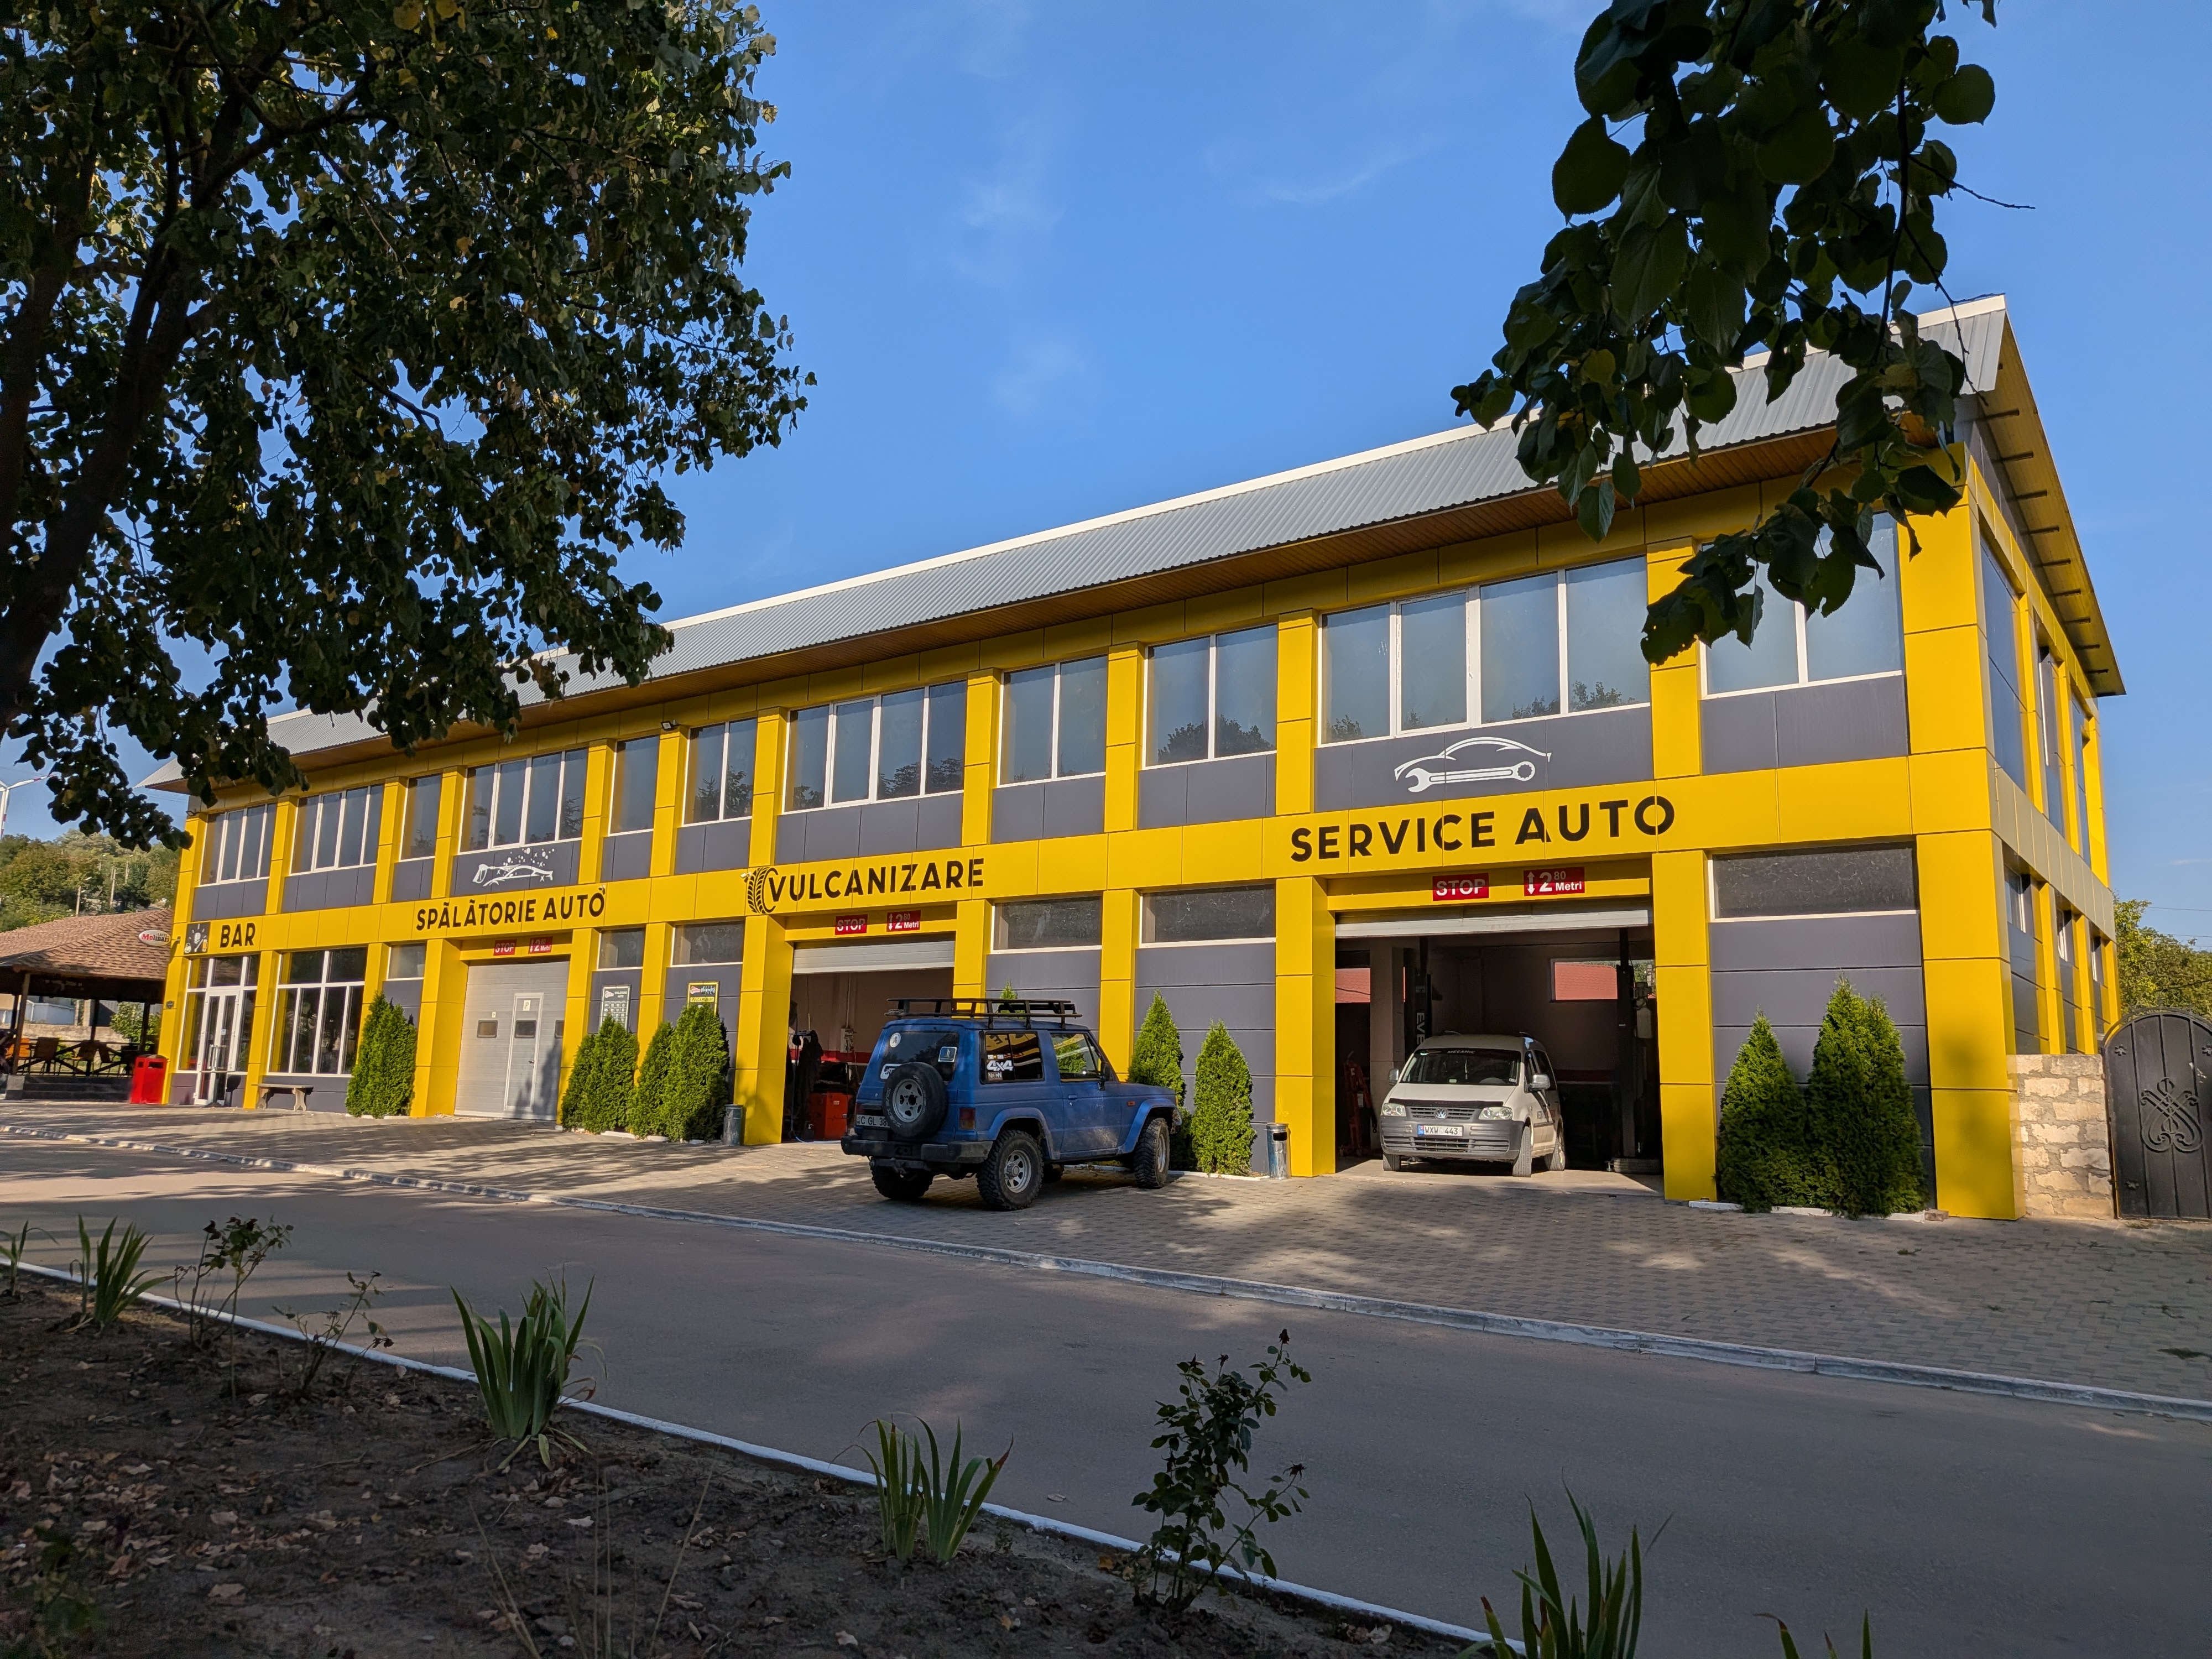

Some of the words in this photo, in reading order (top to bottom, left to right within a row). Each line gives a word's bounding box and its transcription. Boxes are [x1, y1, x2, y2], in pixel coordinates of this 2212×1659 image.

[1290, 811, 1495, 862] SERVICE
[1515, 795, 1674, 845] AUTO
[768, 858, 984, 902] VULCANIZARE
[1436, 879, 1485, 896] STOP
[1539, 872, 1553, 892] 2
[1553, 871, 1566, 880] 80
[1556, 881, 1582, 891] Metri
[542, 893, 604, 921] AUTO
[837, 918, 865, 931] STOP
[894, 914, 902, 929] 2
[142, 933, 169, 942] Molinari
[220, 922, 255, 948] BAR
[495, 942, 515, 953] STOP
[861, 1116, 865, 1124] C
[868, 1117, 877, 1125] GL
[879, 1117, 890, 1126] 38
